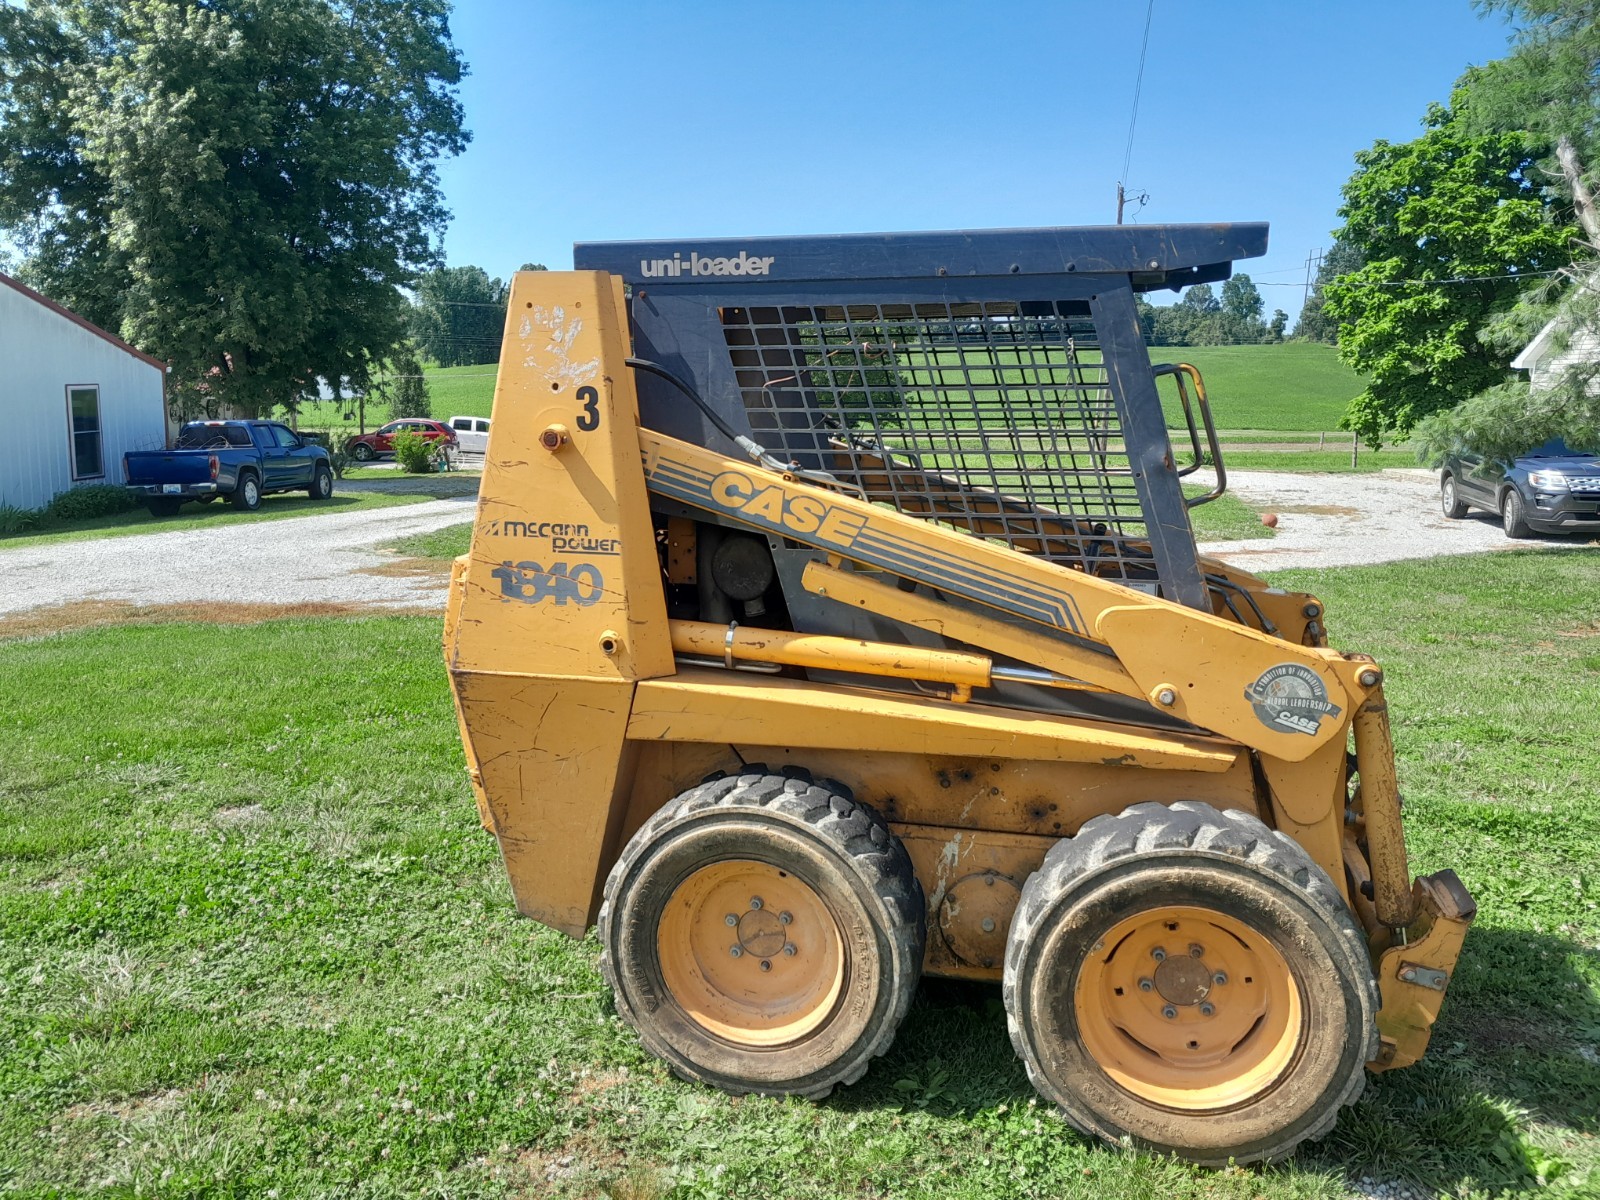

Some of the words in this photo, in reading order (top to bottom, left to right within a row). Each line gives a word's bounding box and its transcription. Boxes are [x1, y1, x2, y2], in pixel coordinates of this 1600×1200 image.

[641, 251, 775, 277] uni-loader
[576, 386, 600, 431] 3
[711, 472, 868, 547] CASE
[491, 560, 604, 607] 1840
[1288, 667, 1296, 675] OF
[1290, 698, 1332, 712] LEADERSHIP
[1279, 711, 1320, 731] CASE
